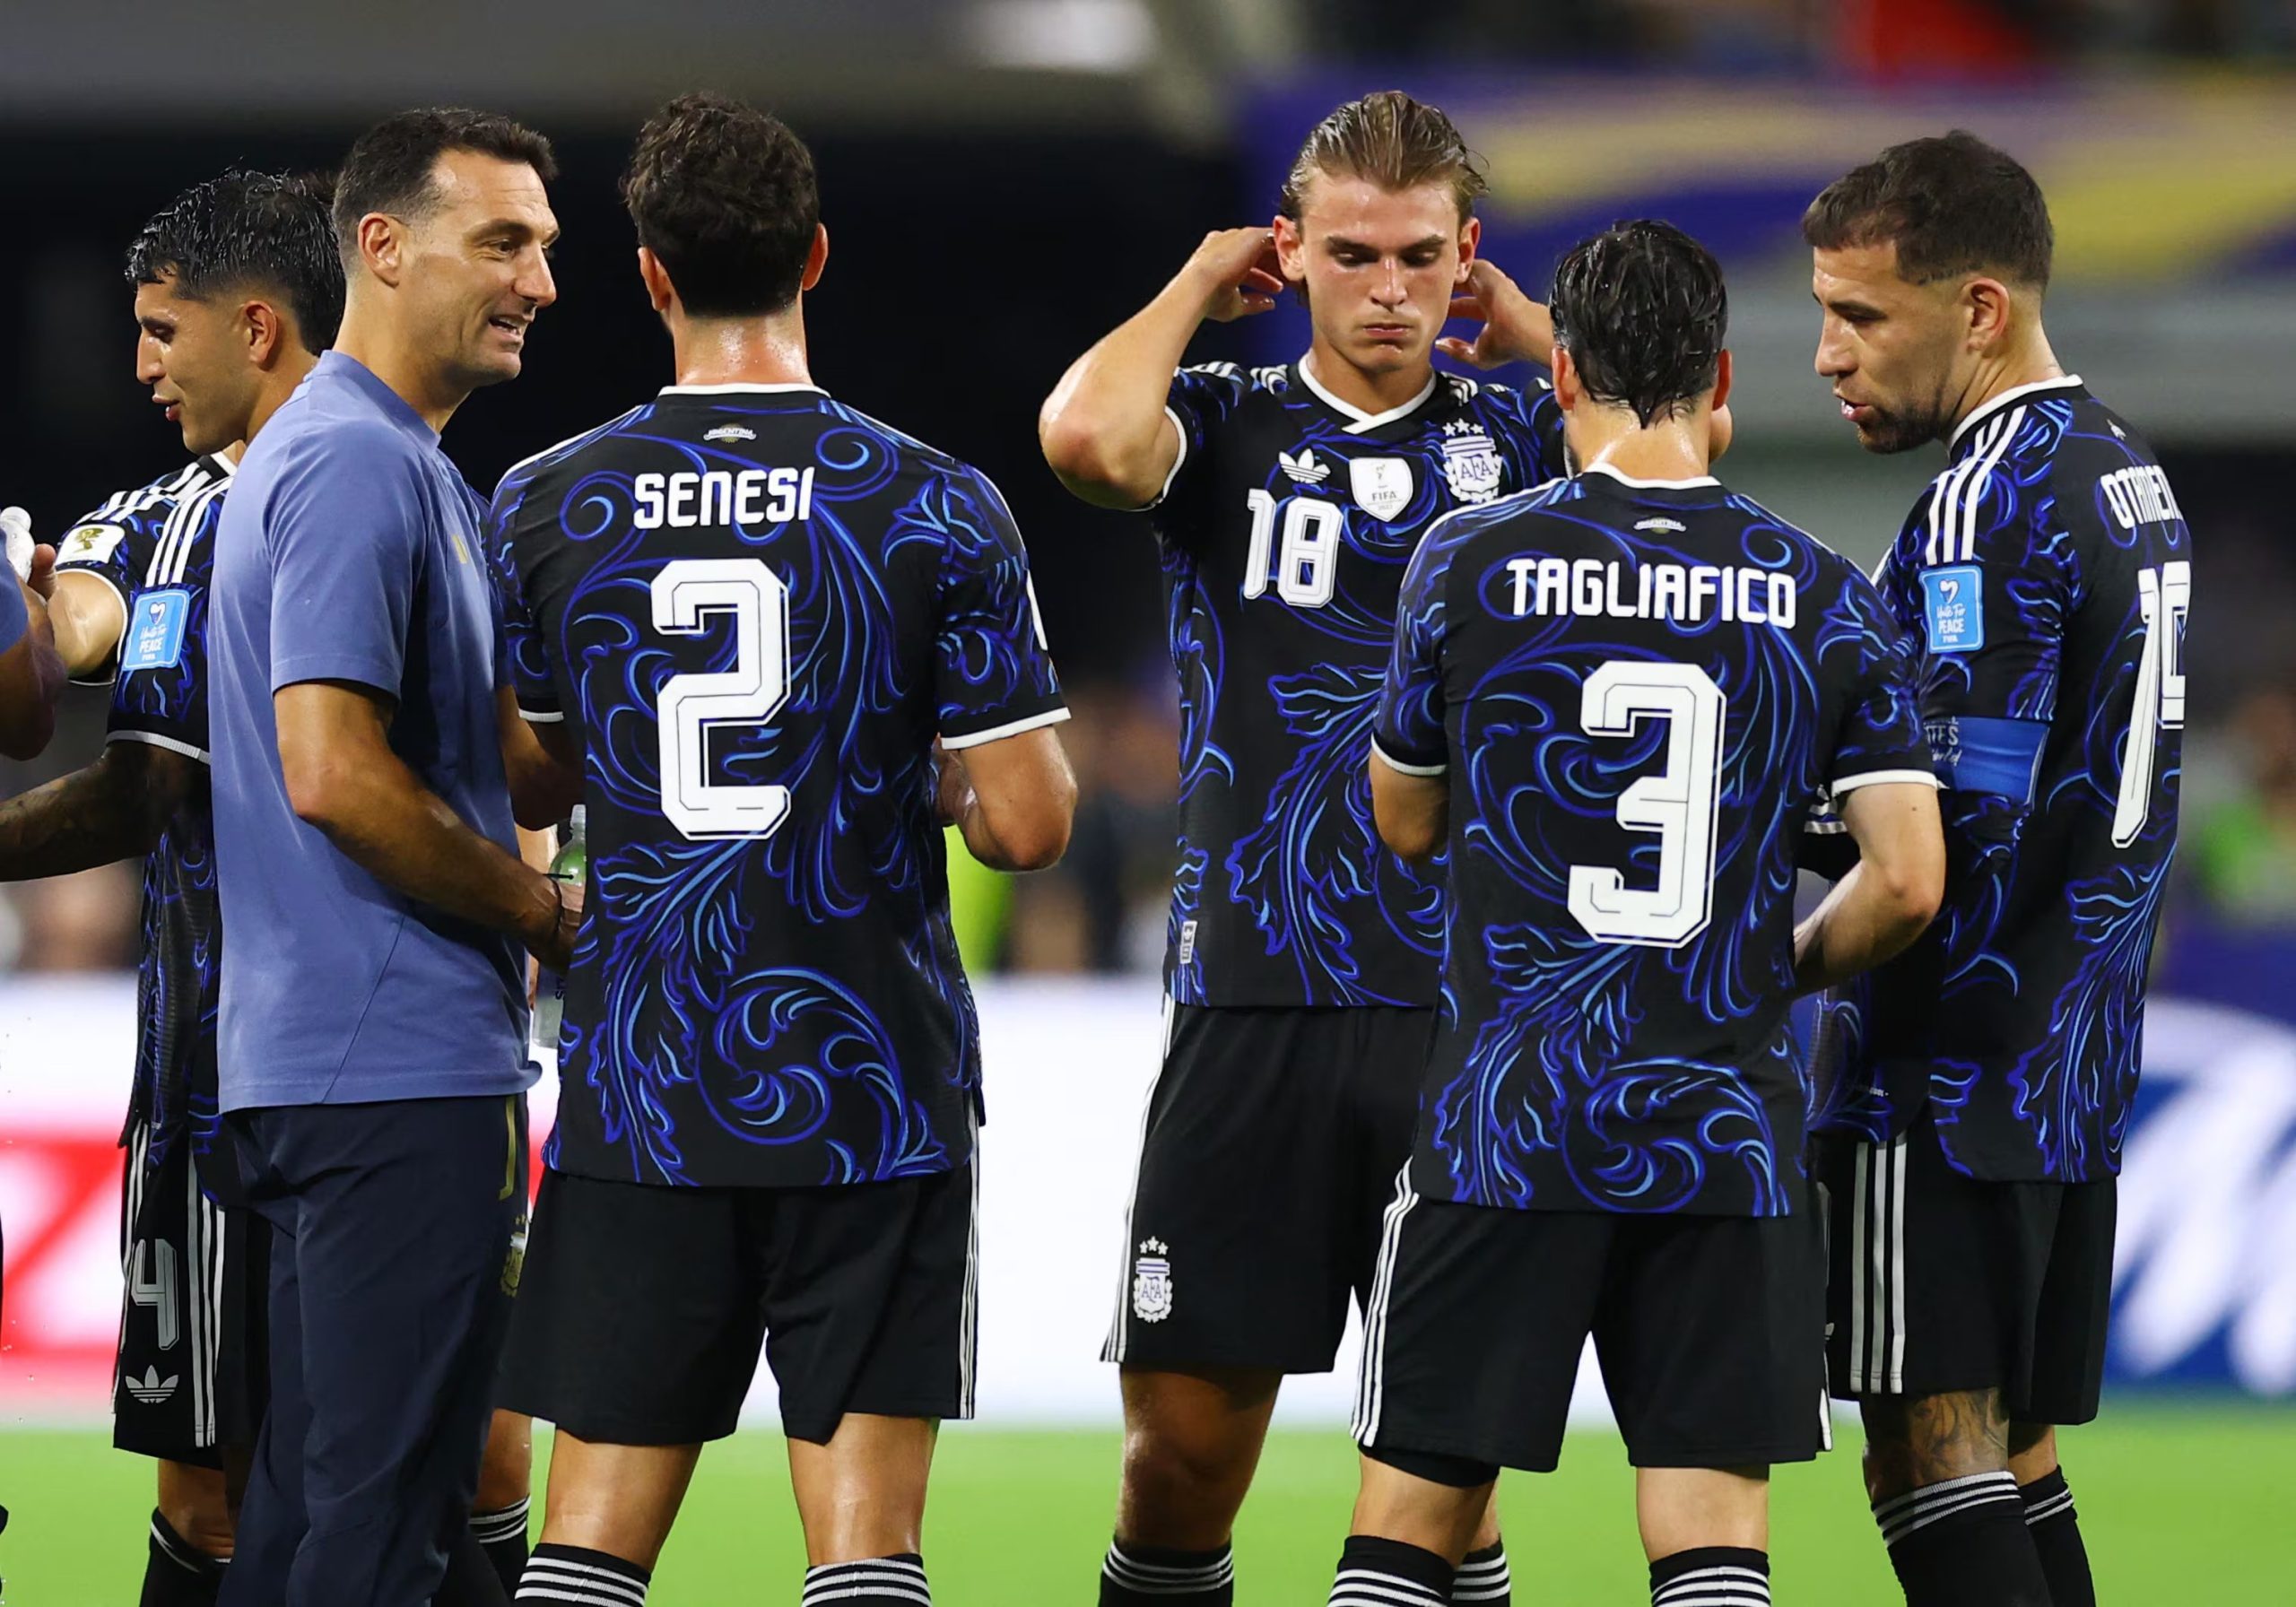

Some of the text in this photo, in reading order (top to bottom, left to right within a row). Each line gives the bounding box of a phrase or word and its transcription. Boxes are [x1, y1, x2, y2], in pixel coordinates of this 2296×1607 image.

[633, 466, 815, 529] SENESI
[1371, 491, 1396, 501] FIFA
[2100, 465, 2184, 530] OTAMEN
[1243, 488, 1344, 609] 18
[1506, 559, 1796, 630] TAGLIAFICO
[650, 558, 791, 840] 2
[1567, 660, 1727, 949] 3
